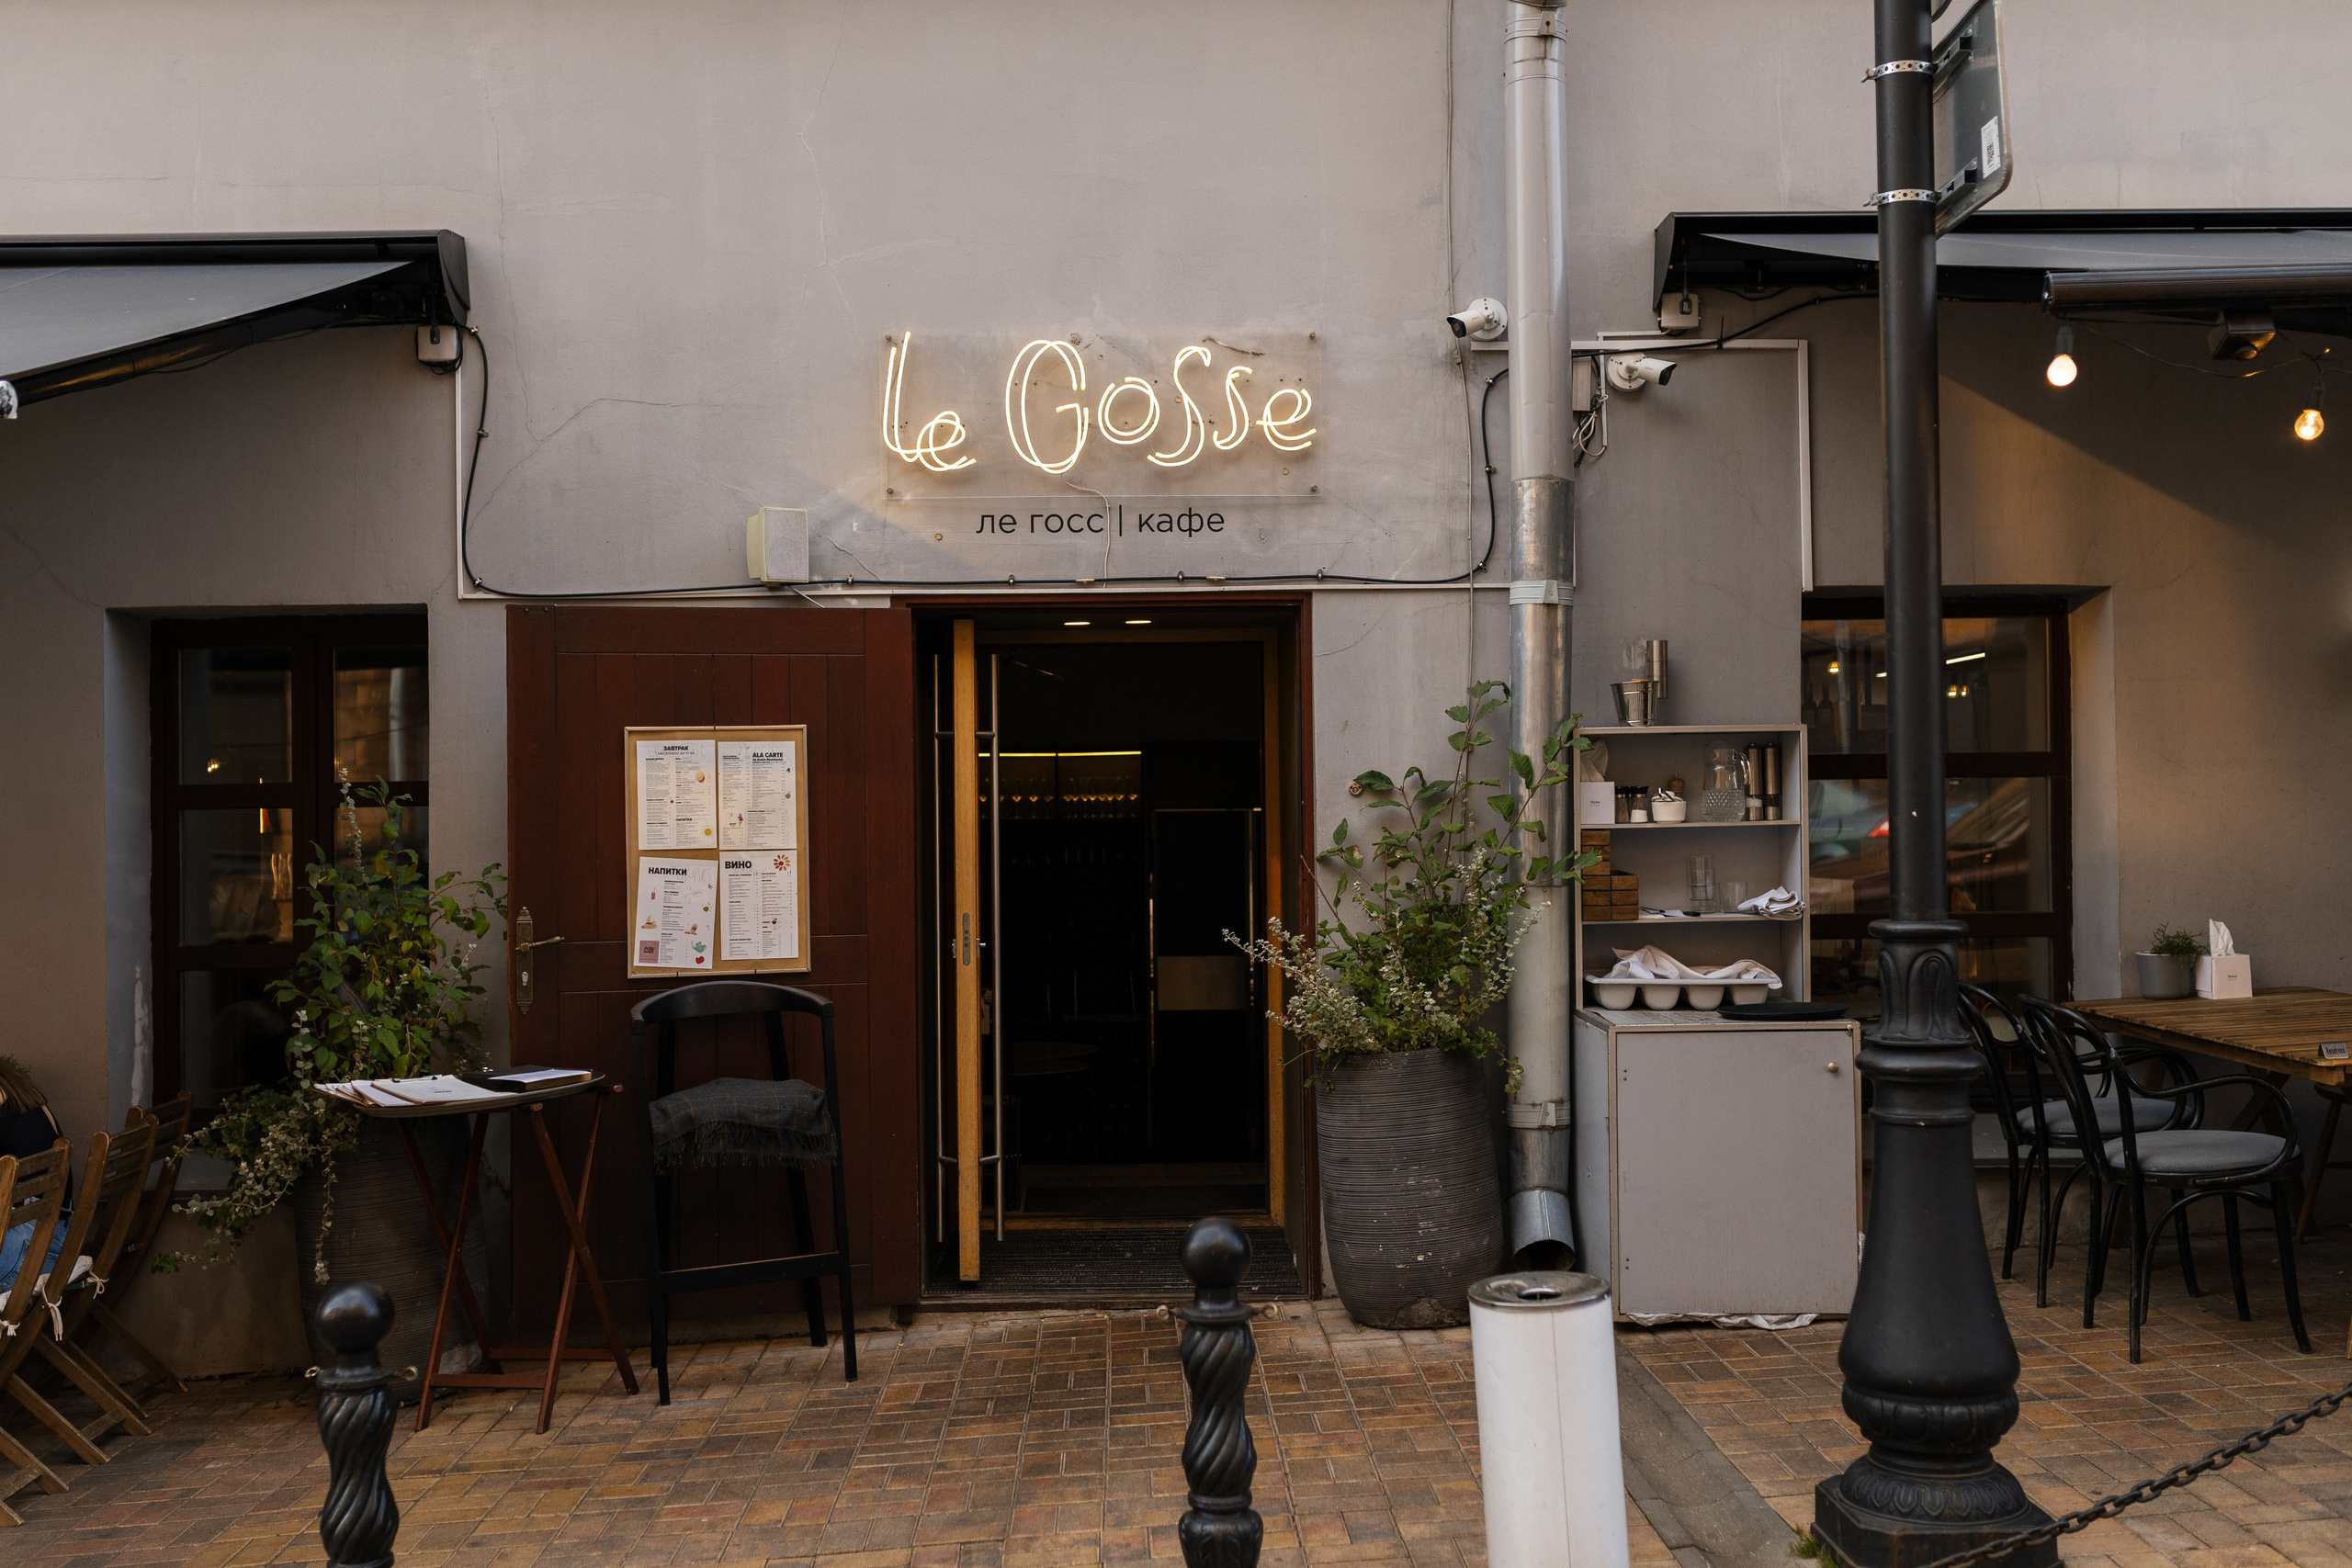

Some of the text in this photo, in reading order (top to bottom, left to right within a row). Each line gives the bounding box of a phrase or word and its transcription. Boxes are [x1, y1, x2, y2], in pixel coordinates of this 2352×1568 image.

[976, 512, 1017, 535] ле
[1030, 512, 1104, 535] госс
[1138, 507, 1226, 542] кафе
[725, 861, 752, 869] ВИНО
[648, 867, 687, 876] НАПИТКИ
